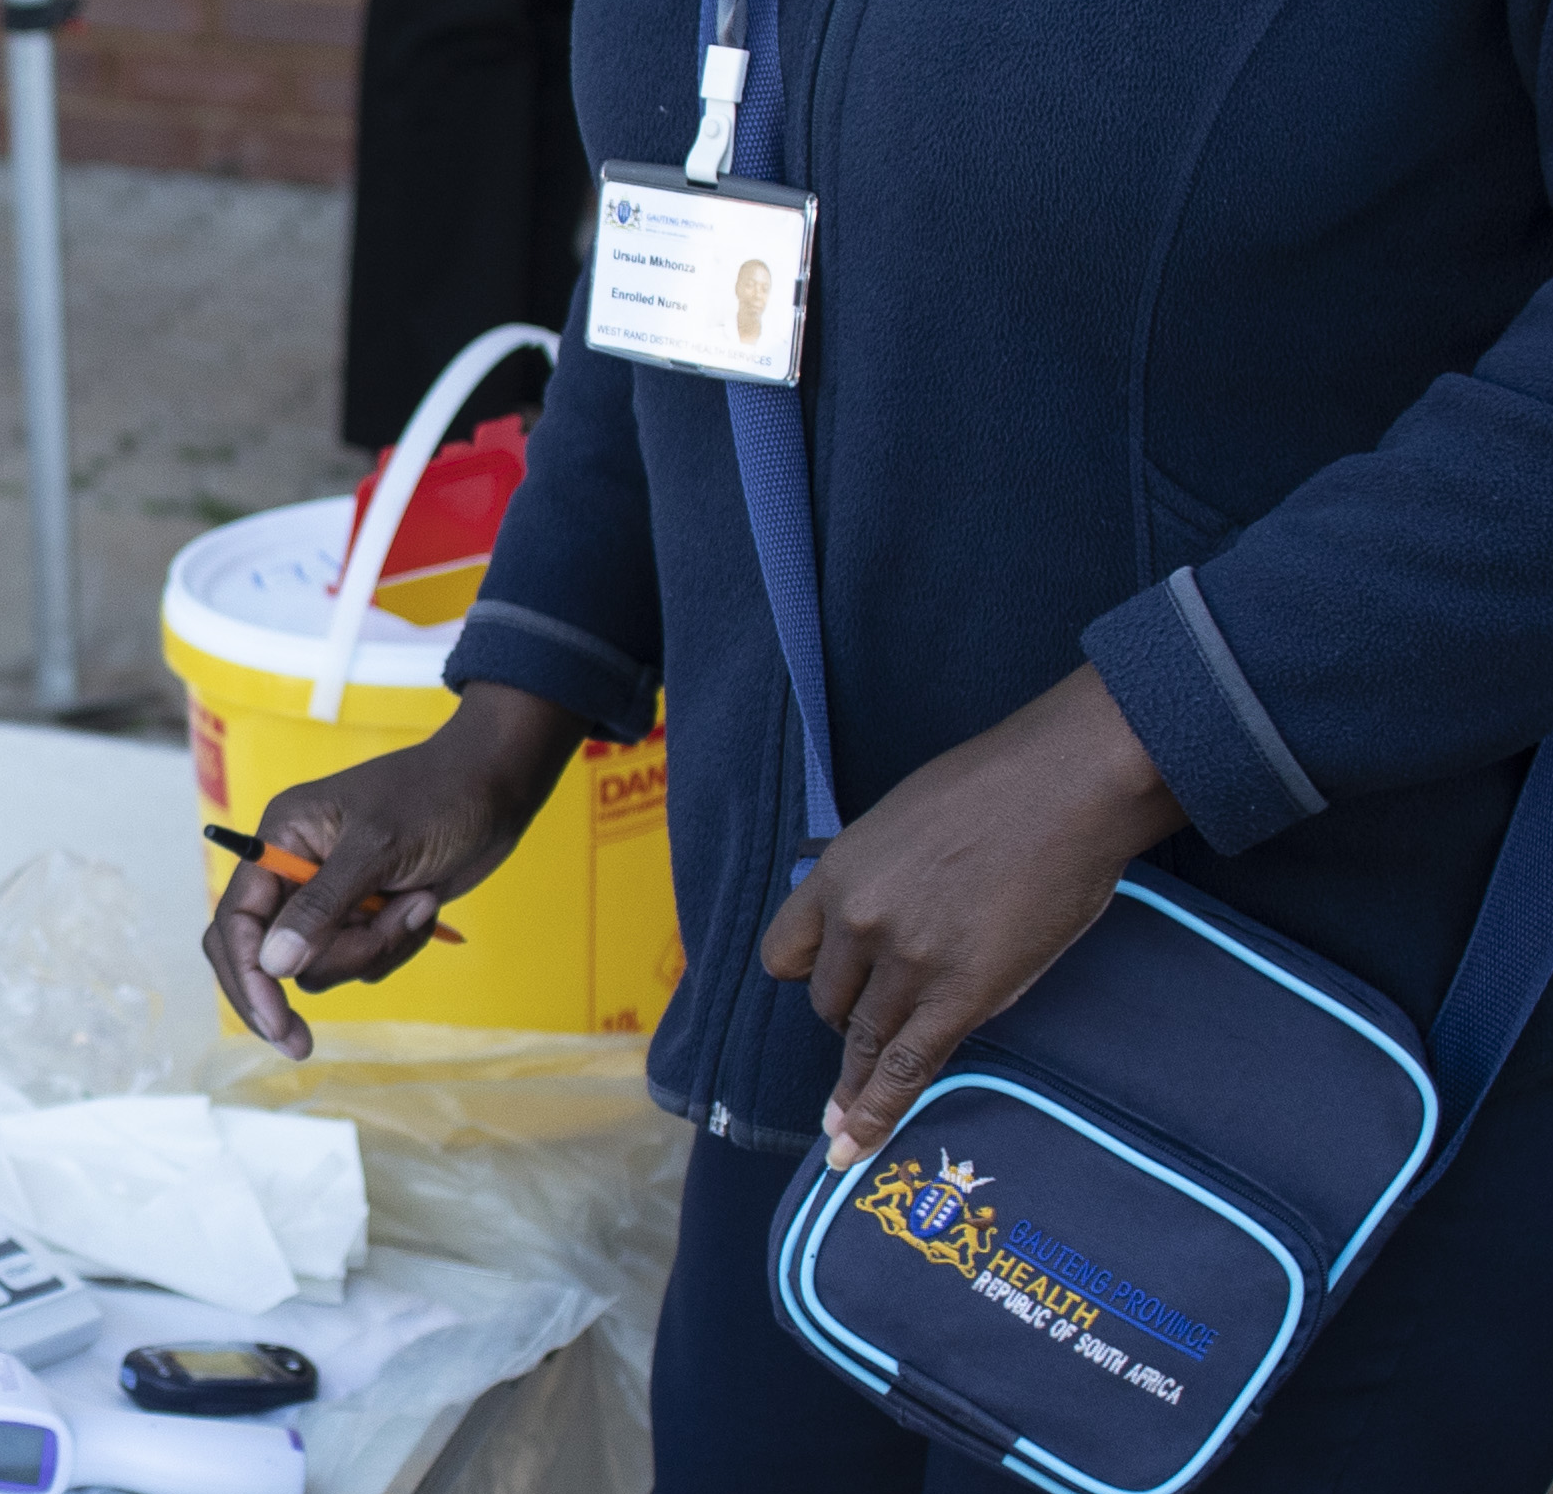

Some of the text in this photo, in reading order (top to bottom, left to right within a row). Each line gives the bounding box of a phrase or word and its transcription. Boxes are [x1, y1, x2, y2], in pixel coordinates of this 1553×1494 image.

[613, 249, 696, 274] Ursula Mkhonza
[611, 287, 688, 311] Enrolled Nurse
[597, 323, 773, 366] WEST RAND DISTRICT HEALTH SERVICES
[600, 763, 668, 806] DAN
[986, 1249, 1101, 1331] HEALTH
[1008, 1219, 1220, 1354] GAUTENG PROVINCE
[971, 1269, 1185, 1406] REPUBLIC OF SOUTH AFRICA
